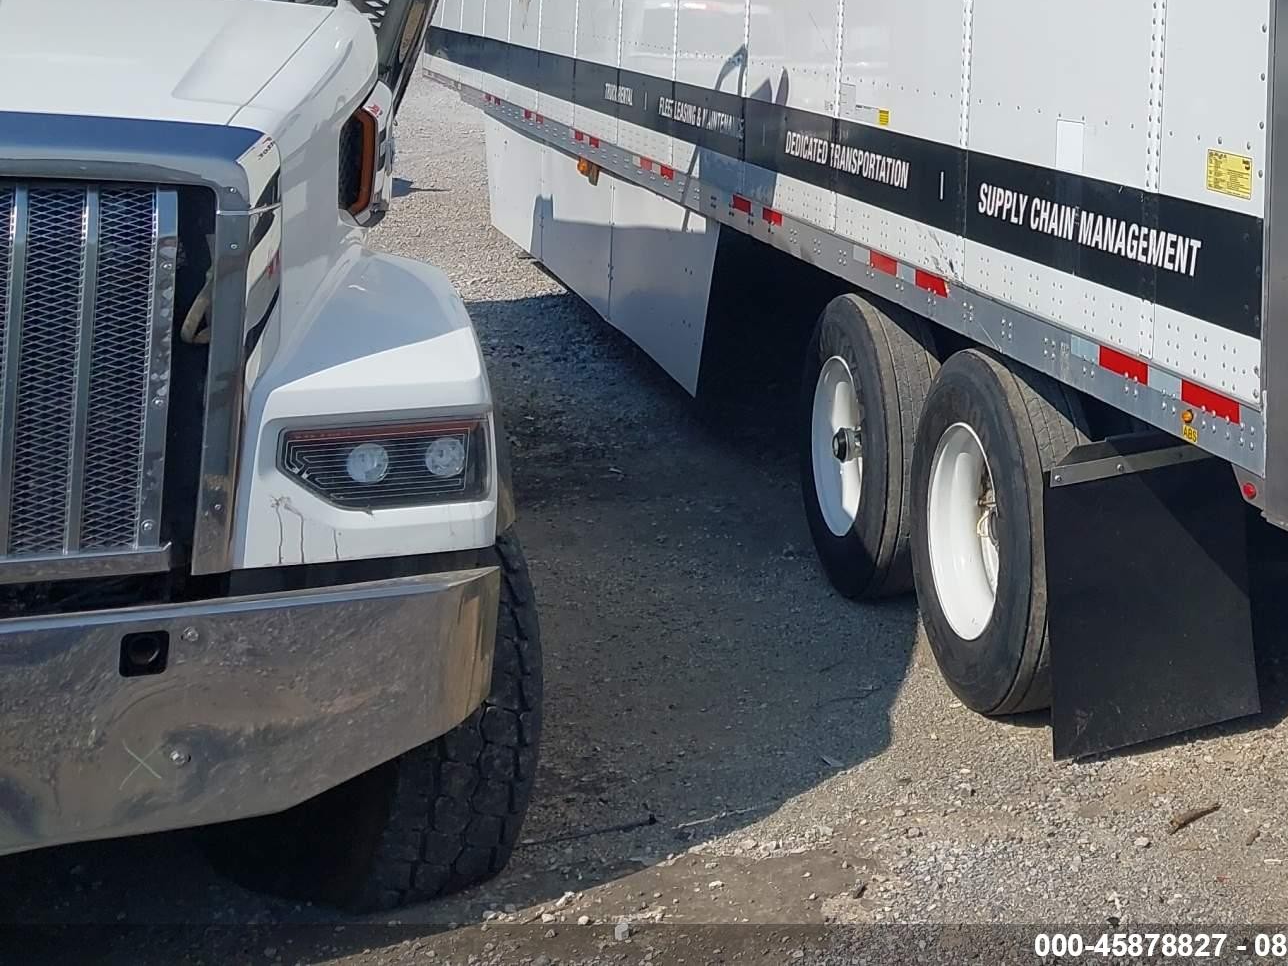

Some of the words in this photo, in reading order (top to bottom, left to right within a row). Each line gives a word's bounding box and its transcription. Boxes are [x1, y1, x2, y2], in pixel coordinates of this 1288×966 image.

[658, 96, 674, 118] FLEET
[674, 101, 697, 126] LEASING
[785, 130, 829, 165] DEDICATED
[829, 141, 910, 190] TRANSPORTATION
[977, 182, 1029, 226] SUPPLY
[1029, 196, 1077, 241] CHAIN
[1077, 209, 1202, 277] MANAGEMENT
[1183, 425, 1198, 443] ABS
